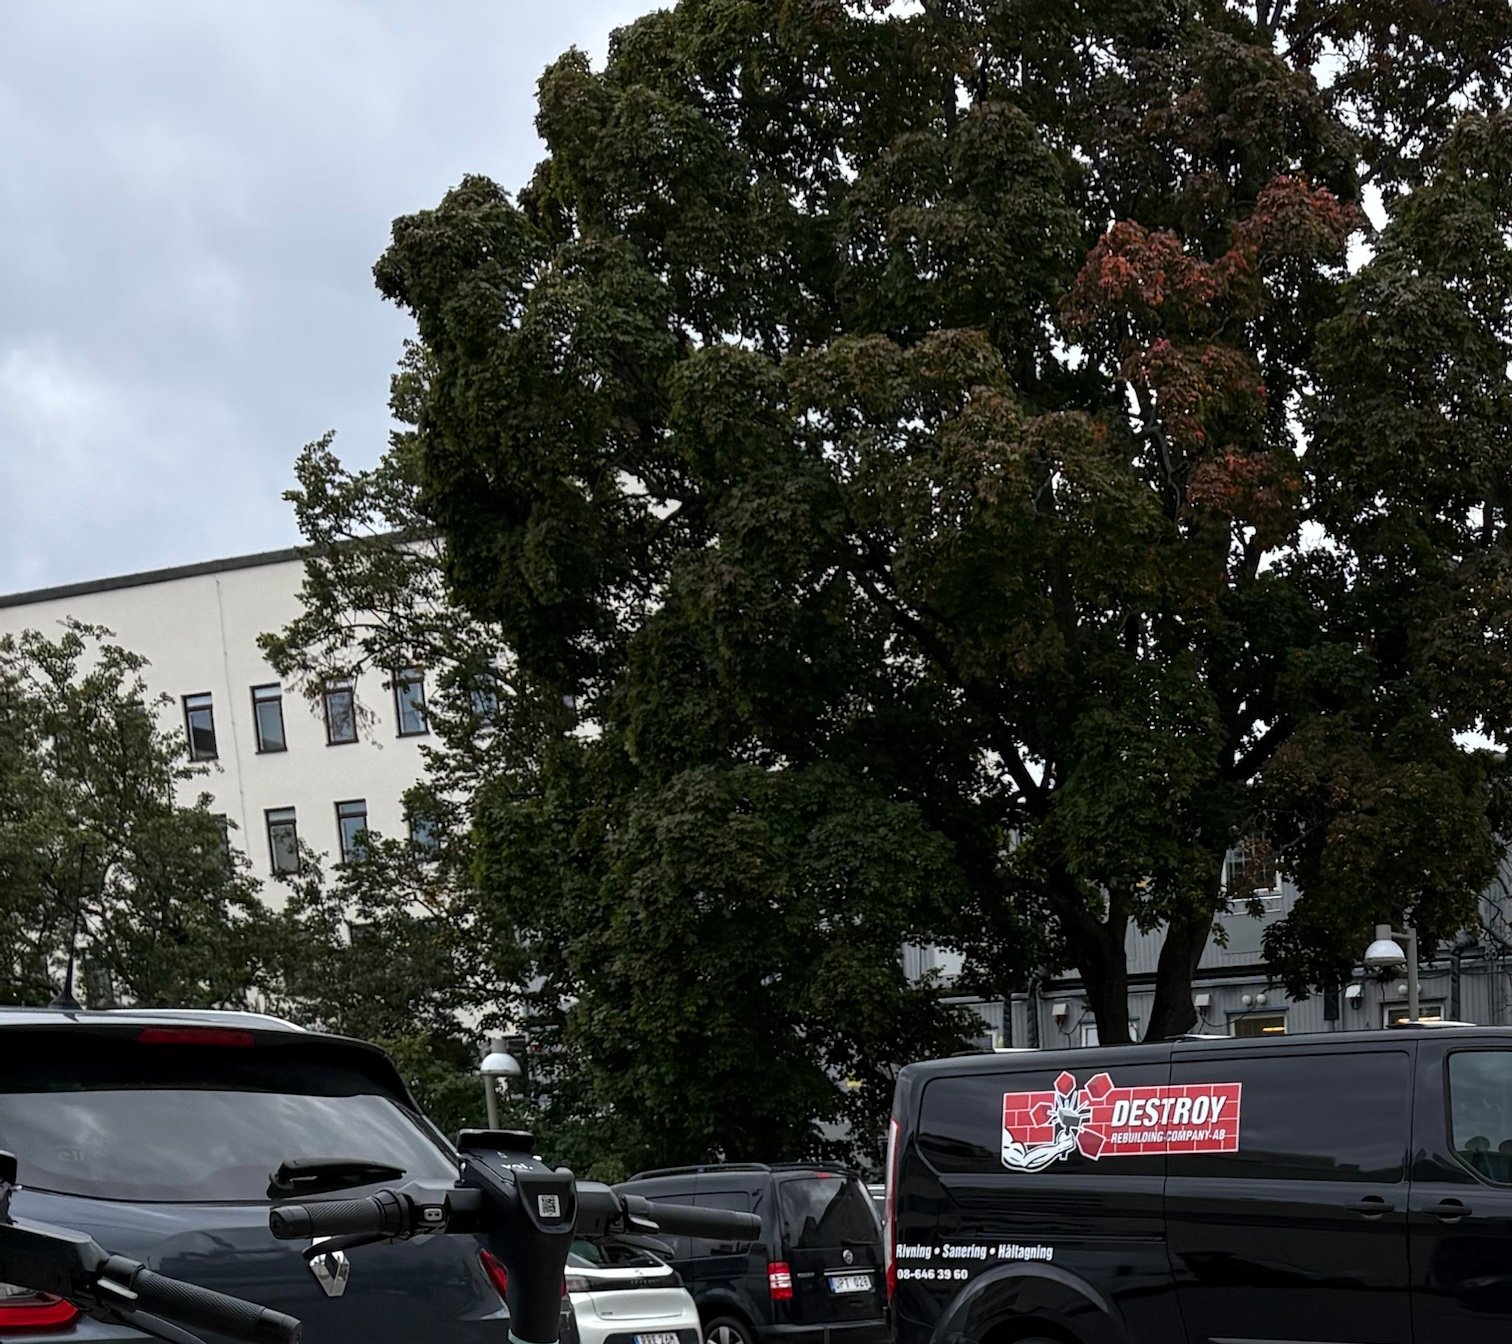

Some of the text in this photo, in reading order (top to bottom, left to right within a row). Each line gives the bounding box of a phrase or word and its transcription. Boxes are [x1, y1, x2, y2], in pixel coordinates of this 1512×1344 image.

[1110, 1095, 1228, 1127] DESTROY
[1110, 1128, 1226, 1144] REBUILDING COMPANY AB
[896, 1243, 1054, 1261] Rivning Sanering Håltagning
[896, 1268, 968, 1280] 08-646 39 60
